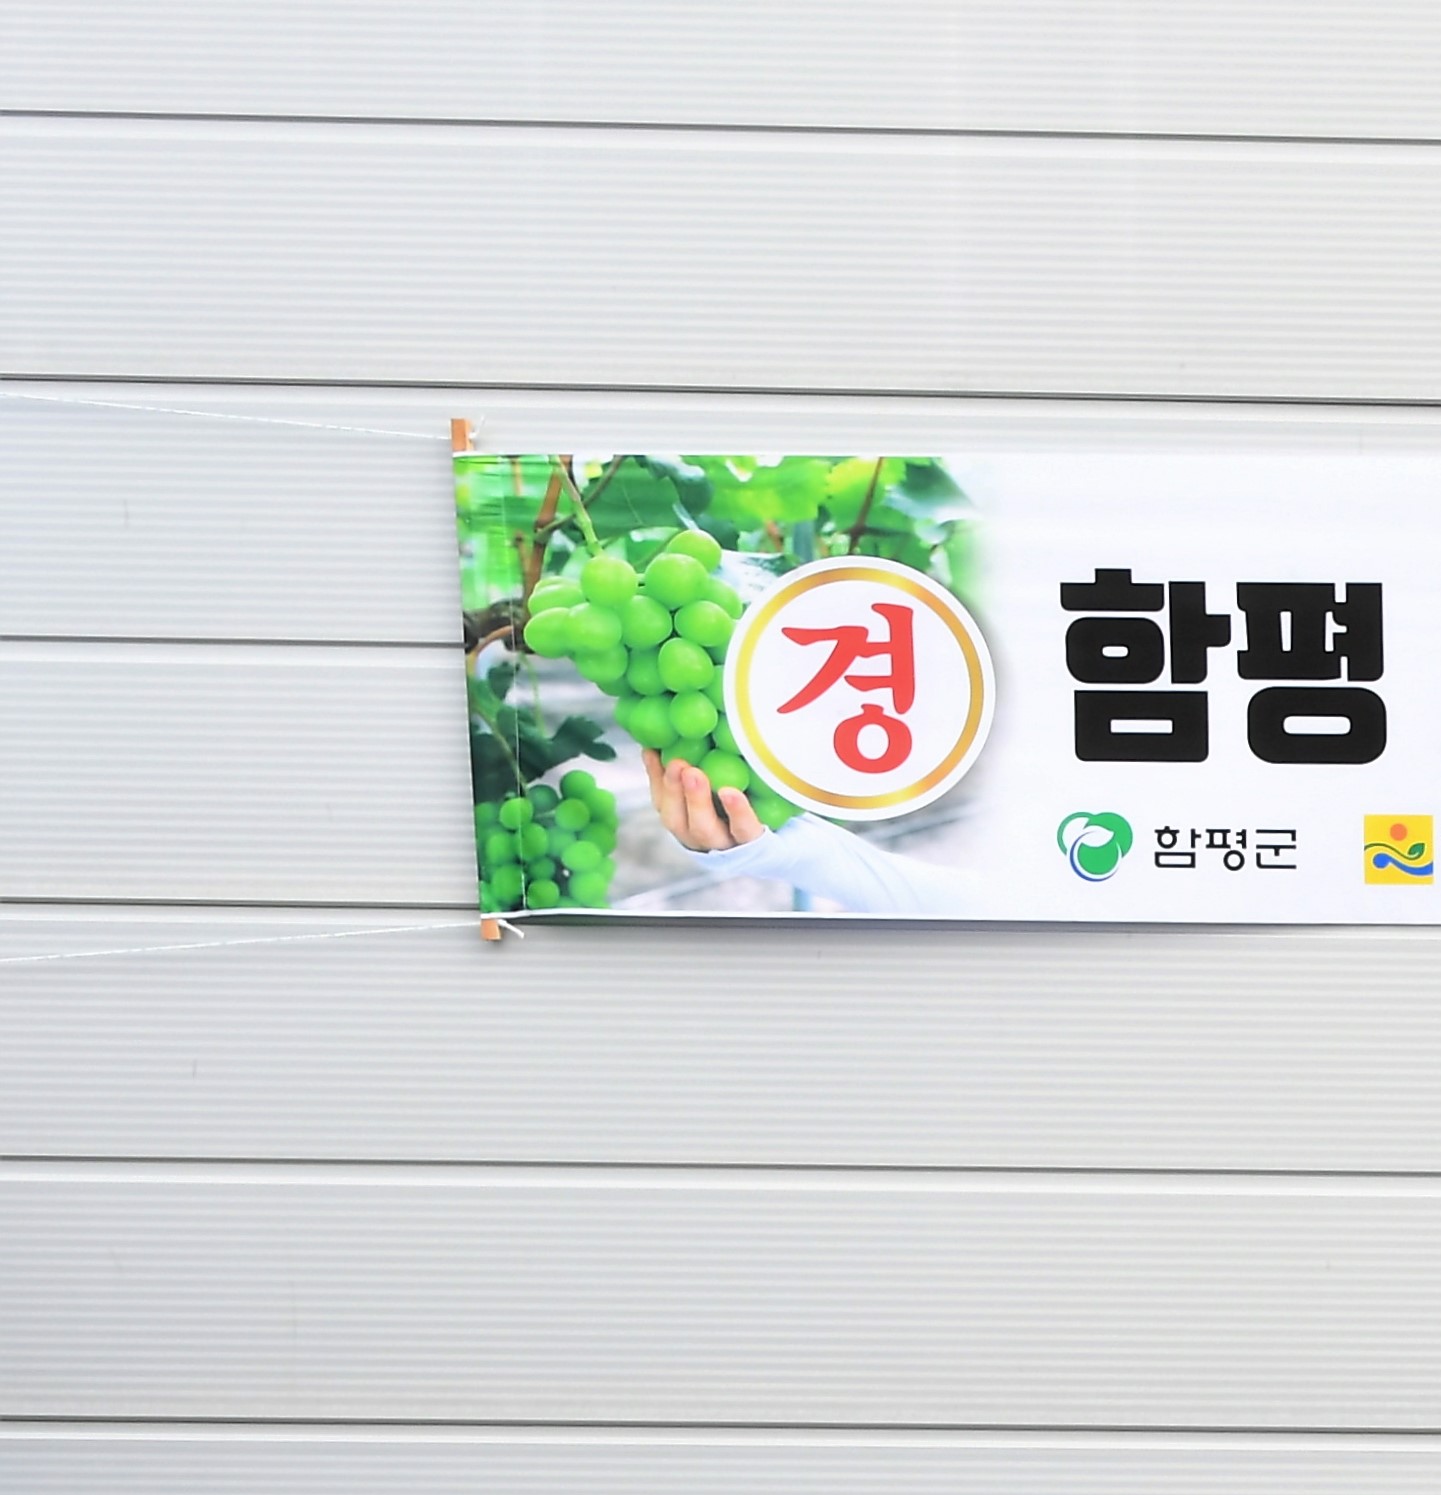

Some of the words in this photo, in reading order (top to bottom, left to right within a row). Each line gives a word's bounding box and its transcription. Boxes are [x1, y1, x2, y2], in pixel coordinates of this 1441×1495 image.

[777, 601, 916, 775] 경
[1058, 567, 1389, 766] 함평
[1153, 824, 1298, 873] 함평군
